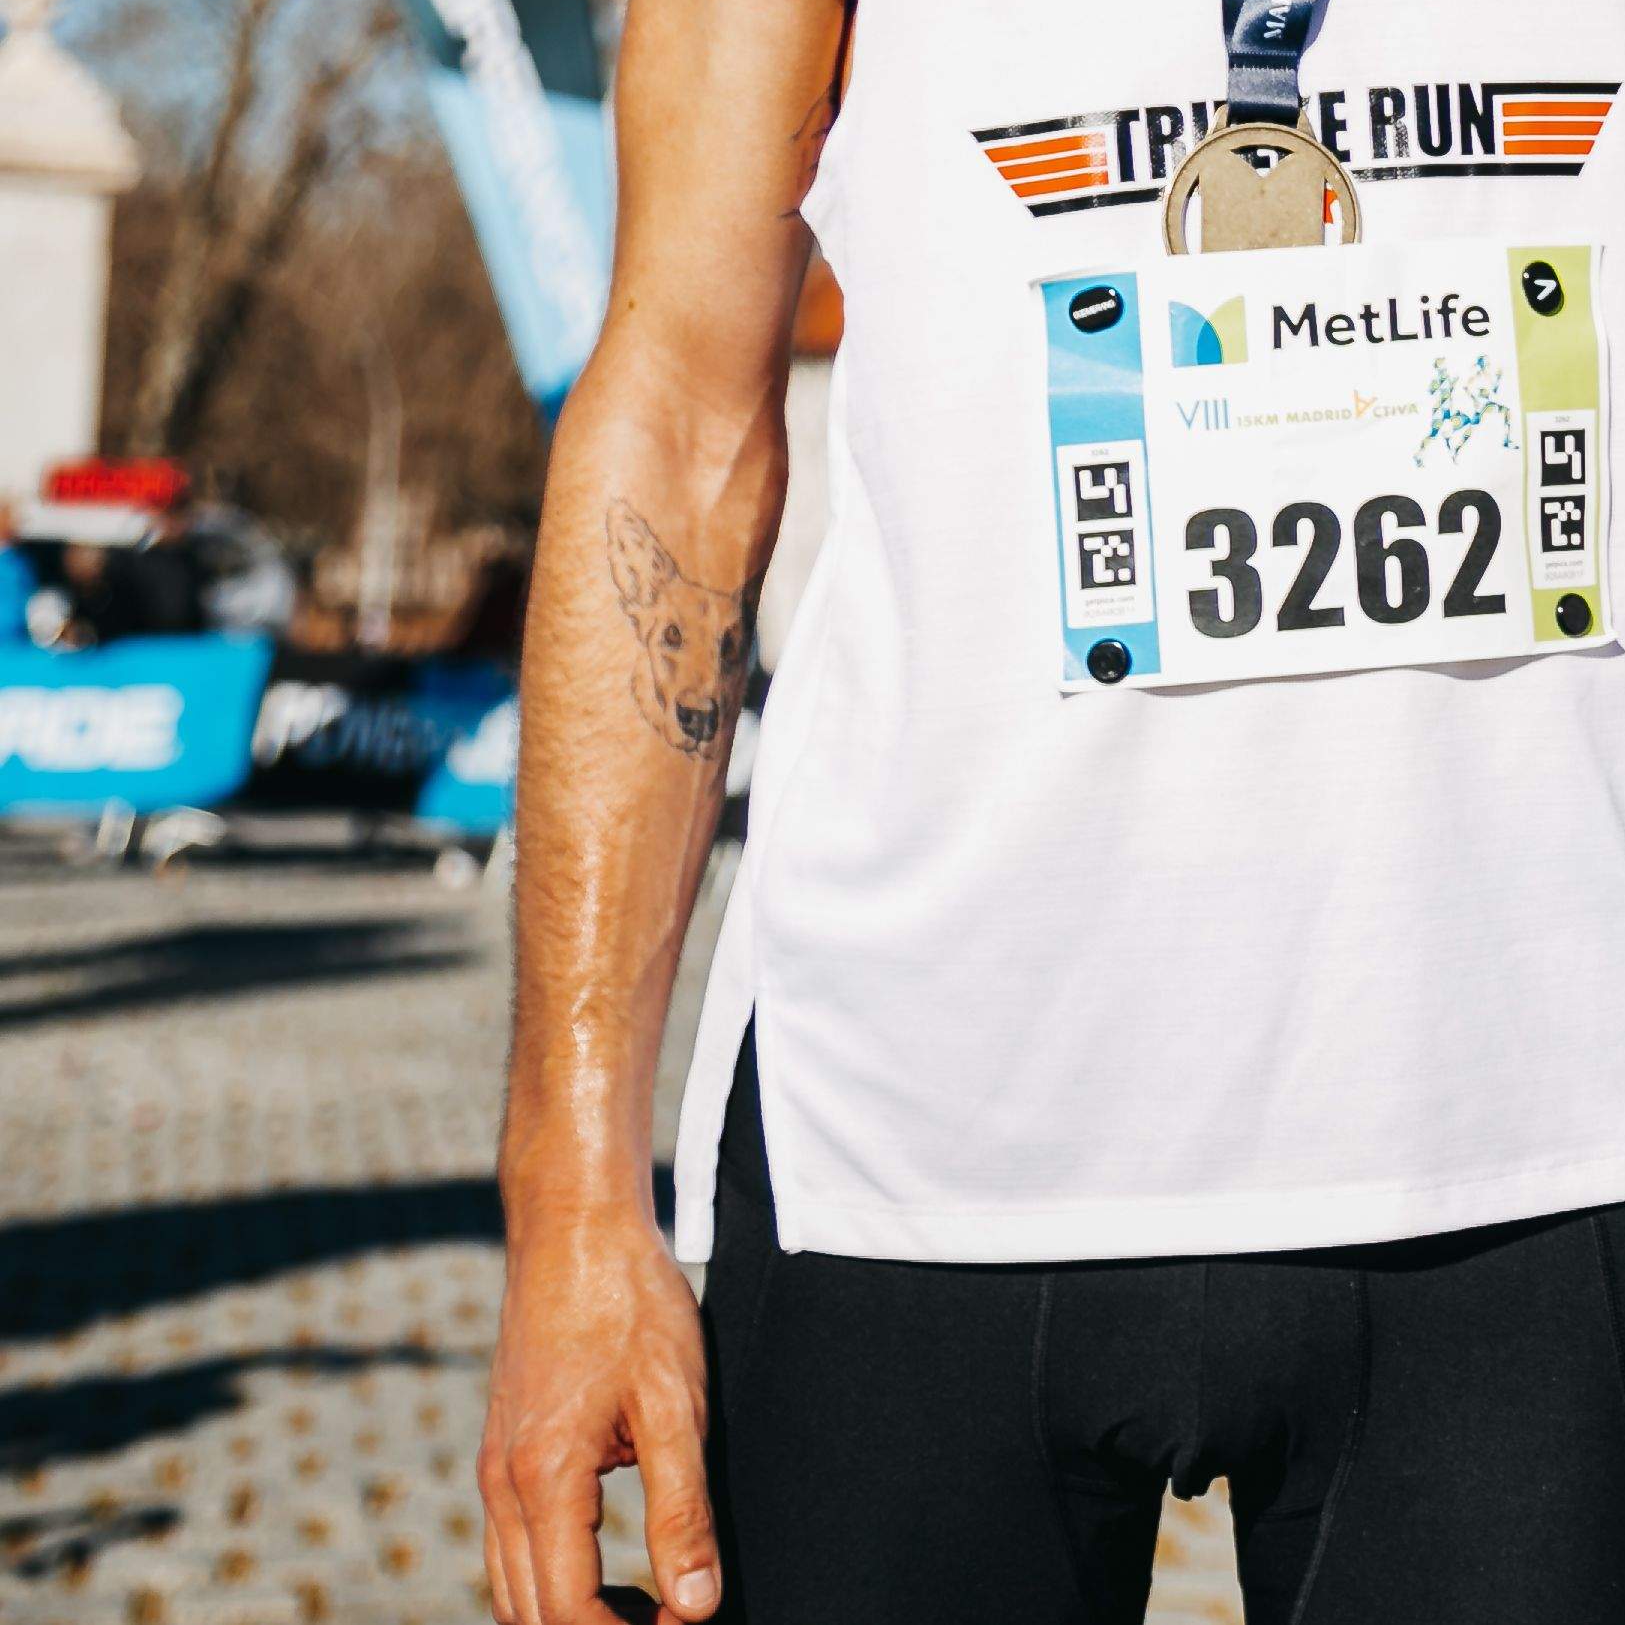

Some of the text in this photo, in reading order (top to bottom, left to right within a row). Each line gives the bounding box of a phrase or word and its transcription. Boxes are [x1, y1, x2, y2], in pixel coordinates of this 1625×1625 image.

[1370, 83, 1496, 160] RUN
[1272, 293, 1490, 350] MetLife
[1175, 398, 1231, 431] VIII
[1236, 414, 1279, 428] 15KM
[1286, 408, 1352, 424] MADRID
[1184, 488, 1506, 639] 3262
